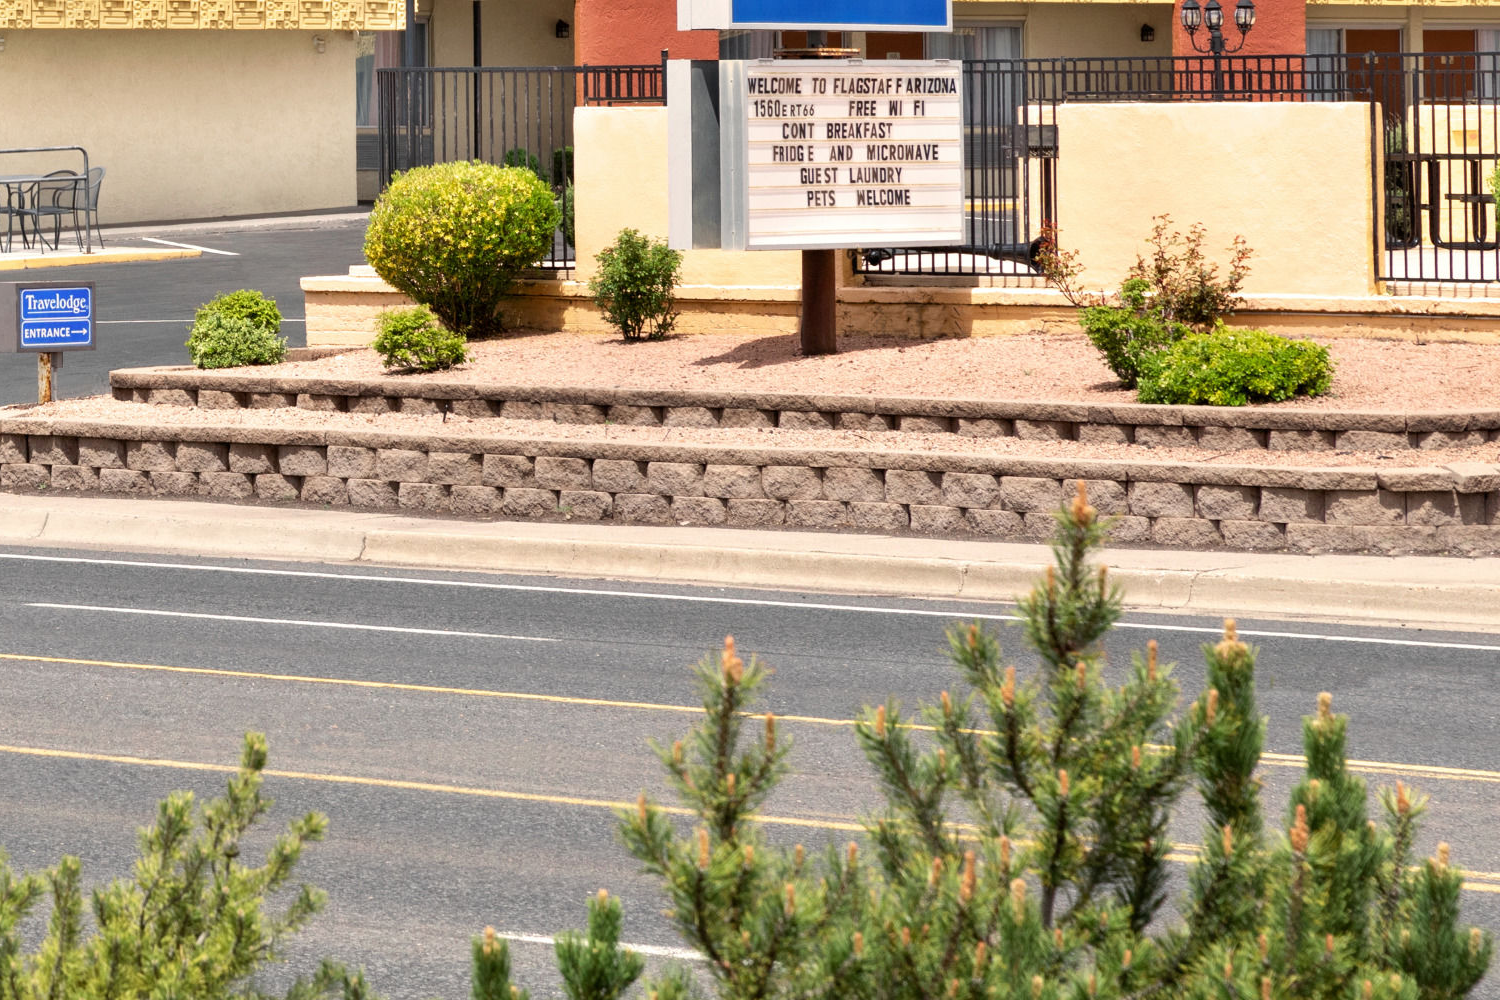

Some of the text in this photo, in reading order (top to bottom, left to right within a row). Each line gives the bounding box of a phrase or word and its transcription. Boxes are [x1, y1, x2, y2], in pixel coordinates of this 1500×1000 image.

[748, 77, 957, 94] WELCOME TO FLAGSTAFF ARIZONA
[849, 100, 925, 116] FREE WI FI
[782, 122, 892, 139] CONT BREAKFAST
[773, 144, 939, 161] FRIDGE AND MICROWAVE
[800, 167, 902, 184] GUEST LAUNDRY
[807, 189, 911, 206] PETS WELCOME
[25, 293, 86, 314] Travelodge
[24, 327, 71, 338] ENTRANCE
